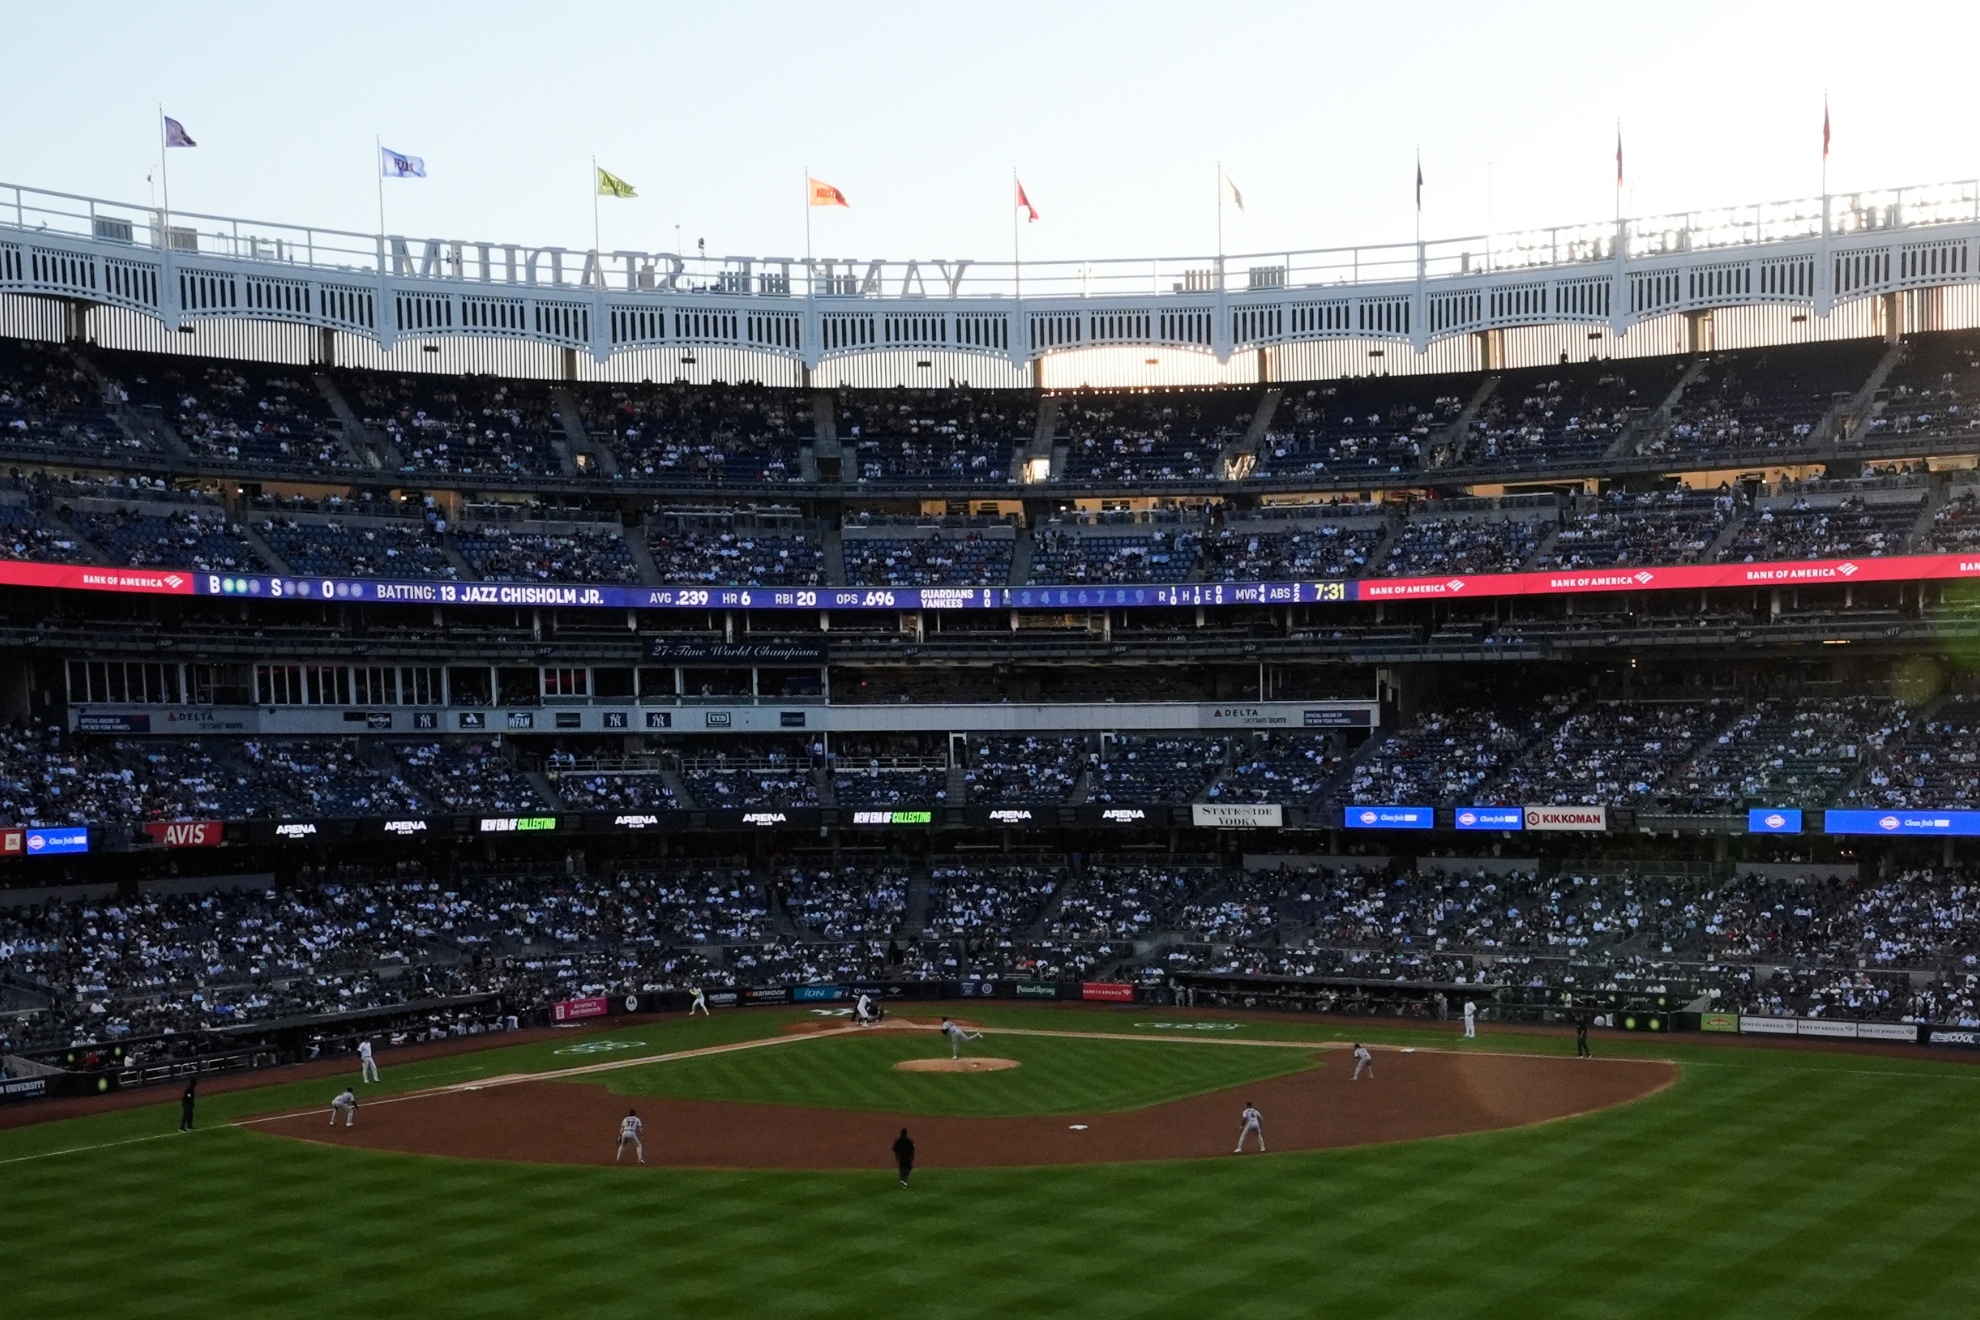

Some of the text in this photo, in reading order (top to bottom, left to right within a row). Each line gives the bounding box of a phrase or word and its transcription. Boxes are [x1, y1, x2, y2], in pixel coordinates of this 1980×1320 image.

[394, 157, 414, 173] TEXAS
[1747, 568, 1836, 580] BANK OF AMERICA
[83, 575, 163, 588] BANK OF AMERICA
[209, 576, 220, 593] B
[272, 578, 282, 596] S
[1551, 577, 1633, 588] BANK OF AMERICA
[378, 585, 604, 604] BATTING: 13 JAZZ CHISHOLM JR.
[920, 589, 992, 599] GUARDIANS 0
[1096, 590, 1106, 603] 7
[1135, 589, 1145, 603] 9
[1158, 586, 1176, 602] R 1
[1182, 586, 1199, 601] H 1
[1205, 585, 1223, 601] E 0
[1235, 584, 1266, 600] MVR 4
[1269, 583, 1301, 599] ABS 2
[1314, 583, 1345, 601] 7:31
[1370, 585, 1446, 595] BANK OF AMERICA
[650, 591, 709, 606] AVG .239
[722, 592, 752, 606] HR 6
[775, 592, 817, 606] RBI 20
[836, 592, 895, 606] OPS .696
[1169, 596, 1178, 605] 0
[1193, 595, 1201, 605] 0
[1215, 594, 1223, 604] 0
[1258, 593, 1266, 603] 4
[1294, 592, 1301, 602] 2
[921, 599, 992, 608] YANKEES 0
[651, 644, 820, 661] 27-Time World Champions
[179, 712, 215, 721] DELTA
[1225, 709, 1259, 717] DELTA
[508, 716, 531, 728] WFAN
[615, 815, 658, 824] ARENA
[743, 813, 786, 822] ARENA
[853, 811, 931, 823] NEW ERA OF COLLECTING
[989, 810, 1031, 819] ARENA
[1102, 810, 1145, 818] ARENA
[1543, 814, 1601, 824] KIKKOMAN
[384, 821, 427, 831] ARENA
[481, 818, 556, 831] NEW ERA OF COLLECTING
[1218, 816, 1257, 826] VODKA
[164, 824, 207, 845] AVIS
[276, 824, 317, 834] ARENA
[1950, 1032, 1975, 1043] COOL
[5, 1080, 46, 1093] UNIVERSITY
